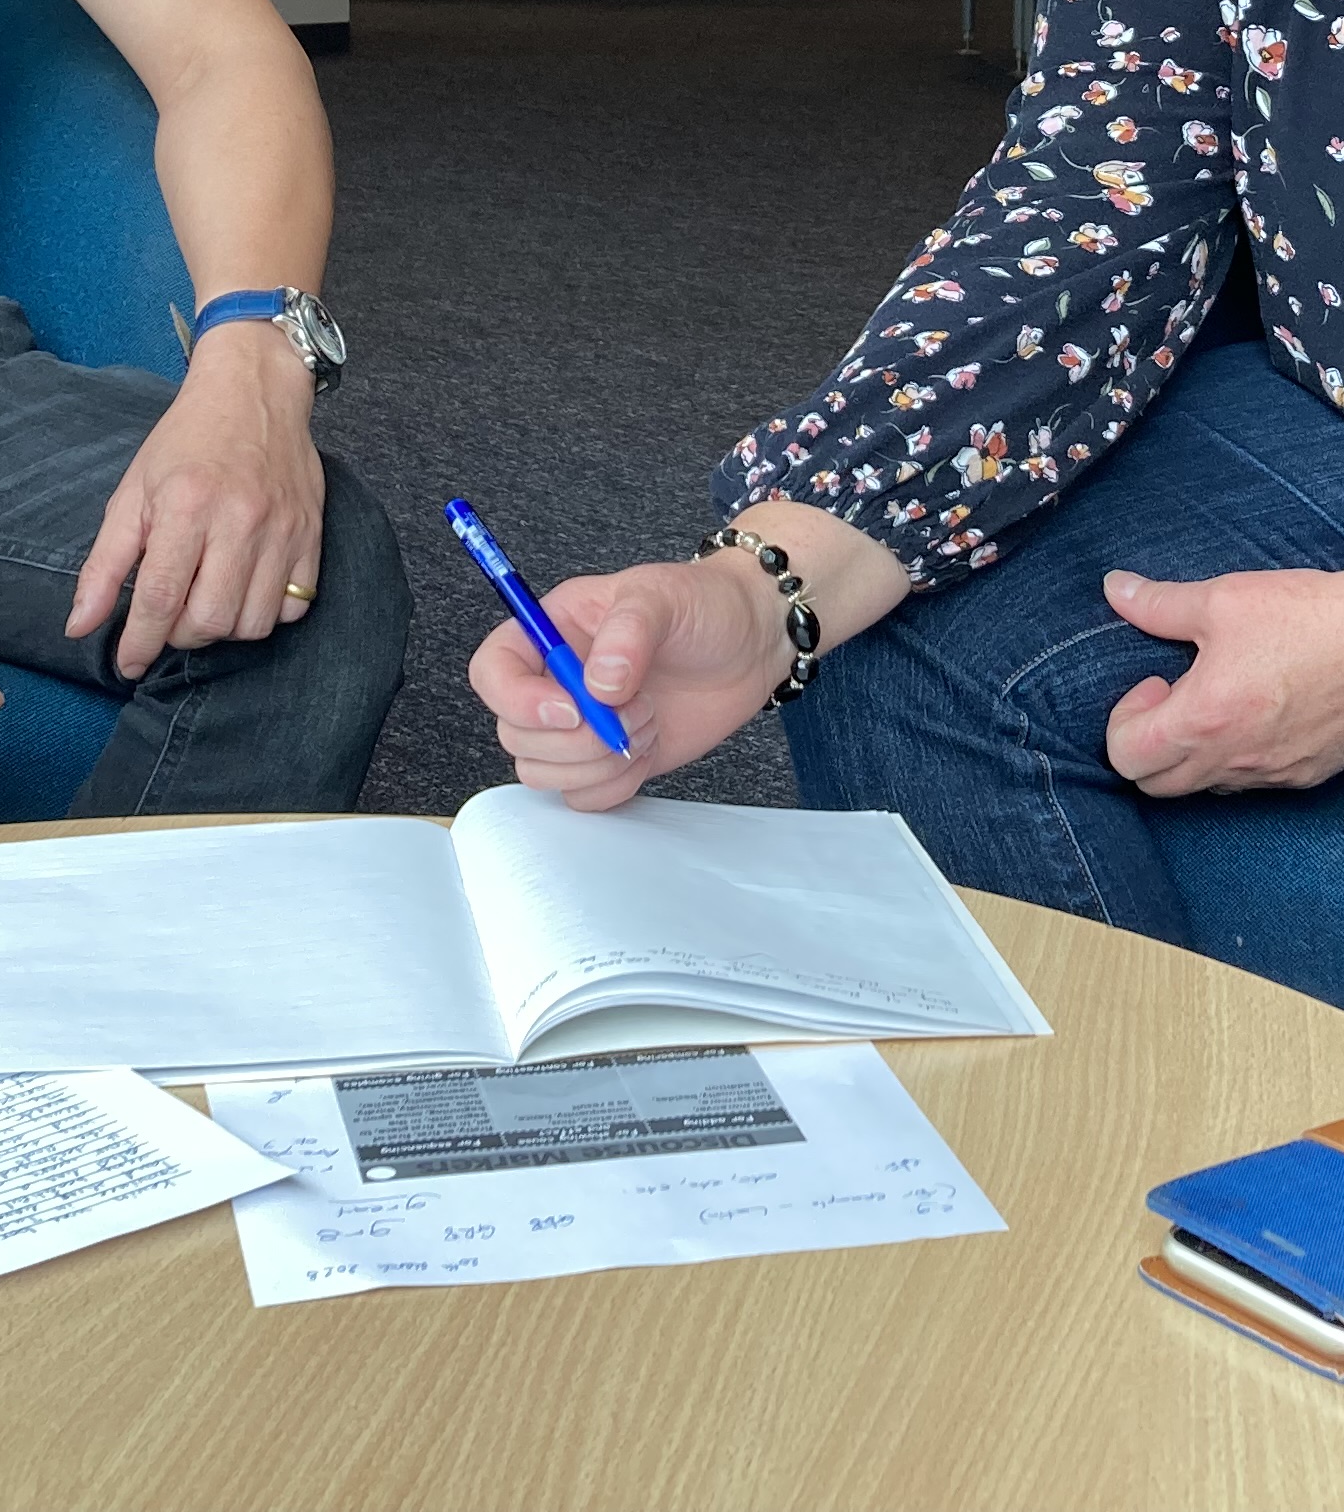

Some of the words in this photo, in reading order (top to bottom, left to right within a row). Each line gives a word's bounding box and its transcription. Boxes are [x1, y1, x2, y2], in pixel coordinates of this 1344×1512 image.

[457, 1138, 481, 1146] For
[582, 1132, 757, 1159] Discourse
[416, 1149, 570, 1174] Markers
